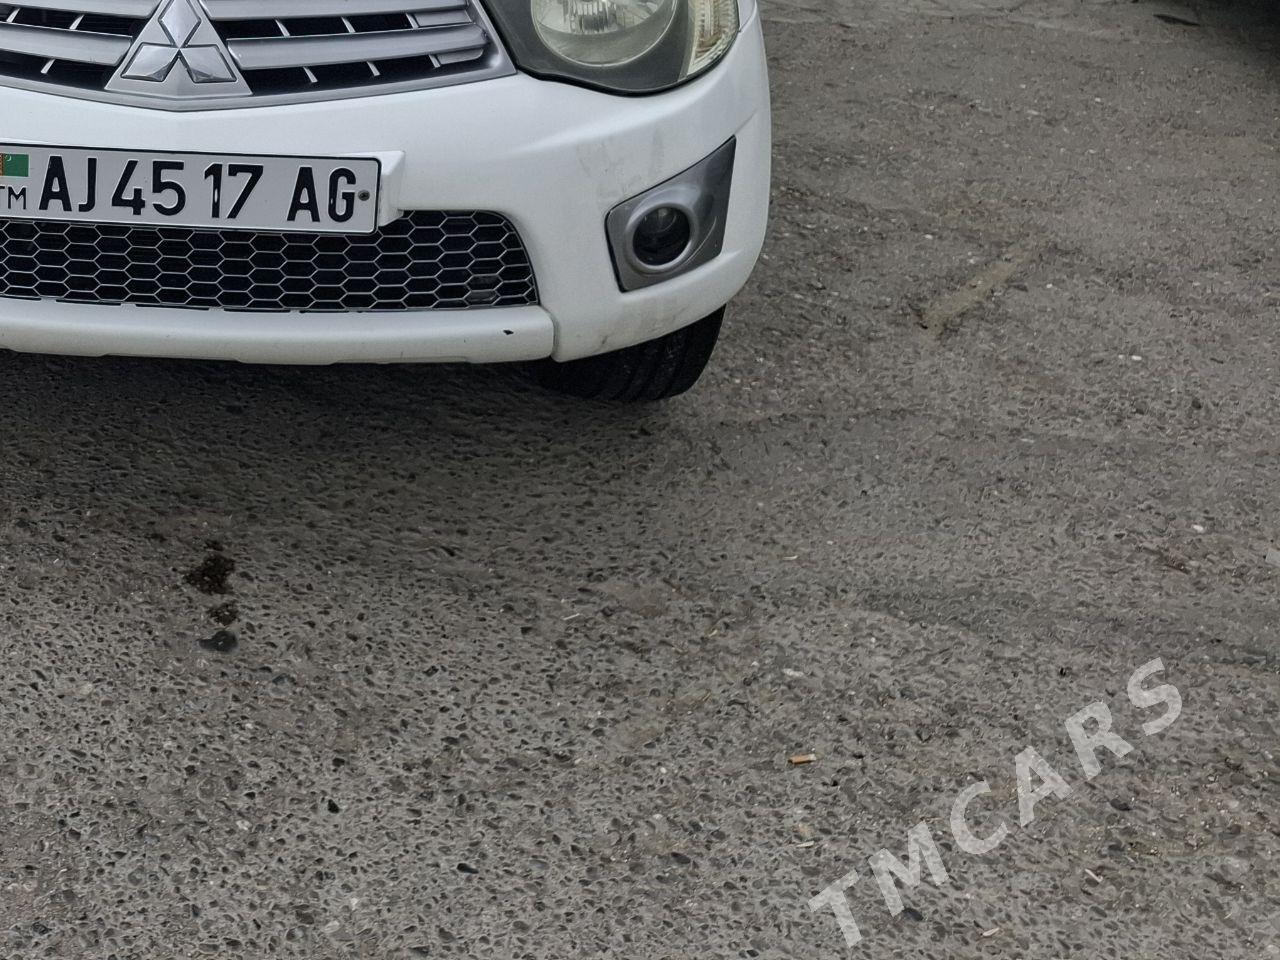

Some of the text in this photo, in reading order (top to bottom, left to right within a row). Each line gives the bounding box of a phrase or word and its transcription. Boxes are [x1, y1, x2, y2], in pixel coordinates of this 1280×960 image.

[38, 155, 98, 213] AJ
[110, 159, 187, 216] 45
[203, 163, 264, 220] 17
[286, 166, 357, 223] AG
